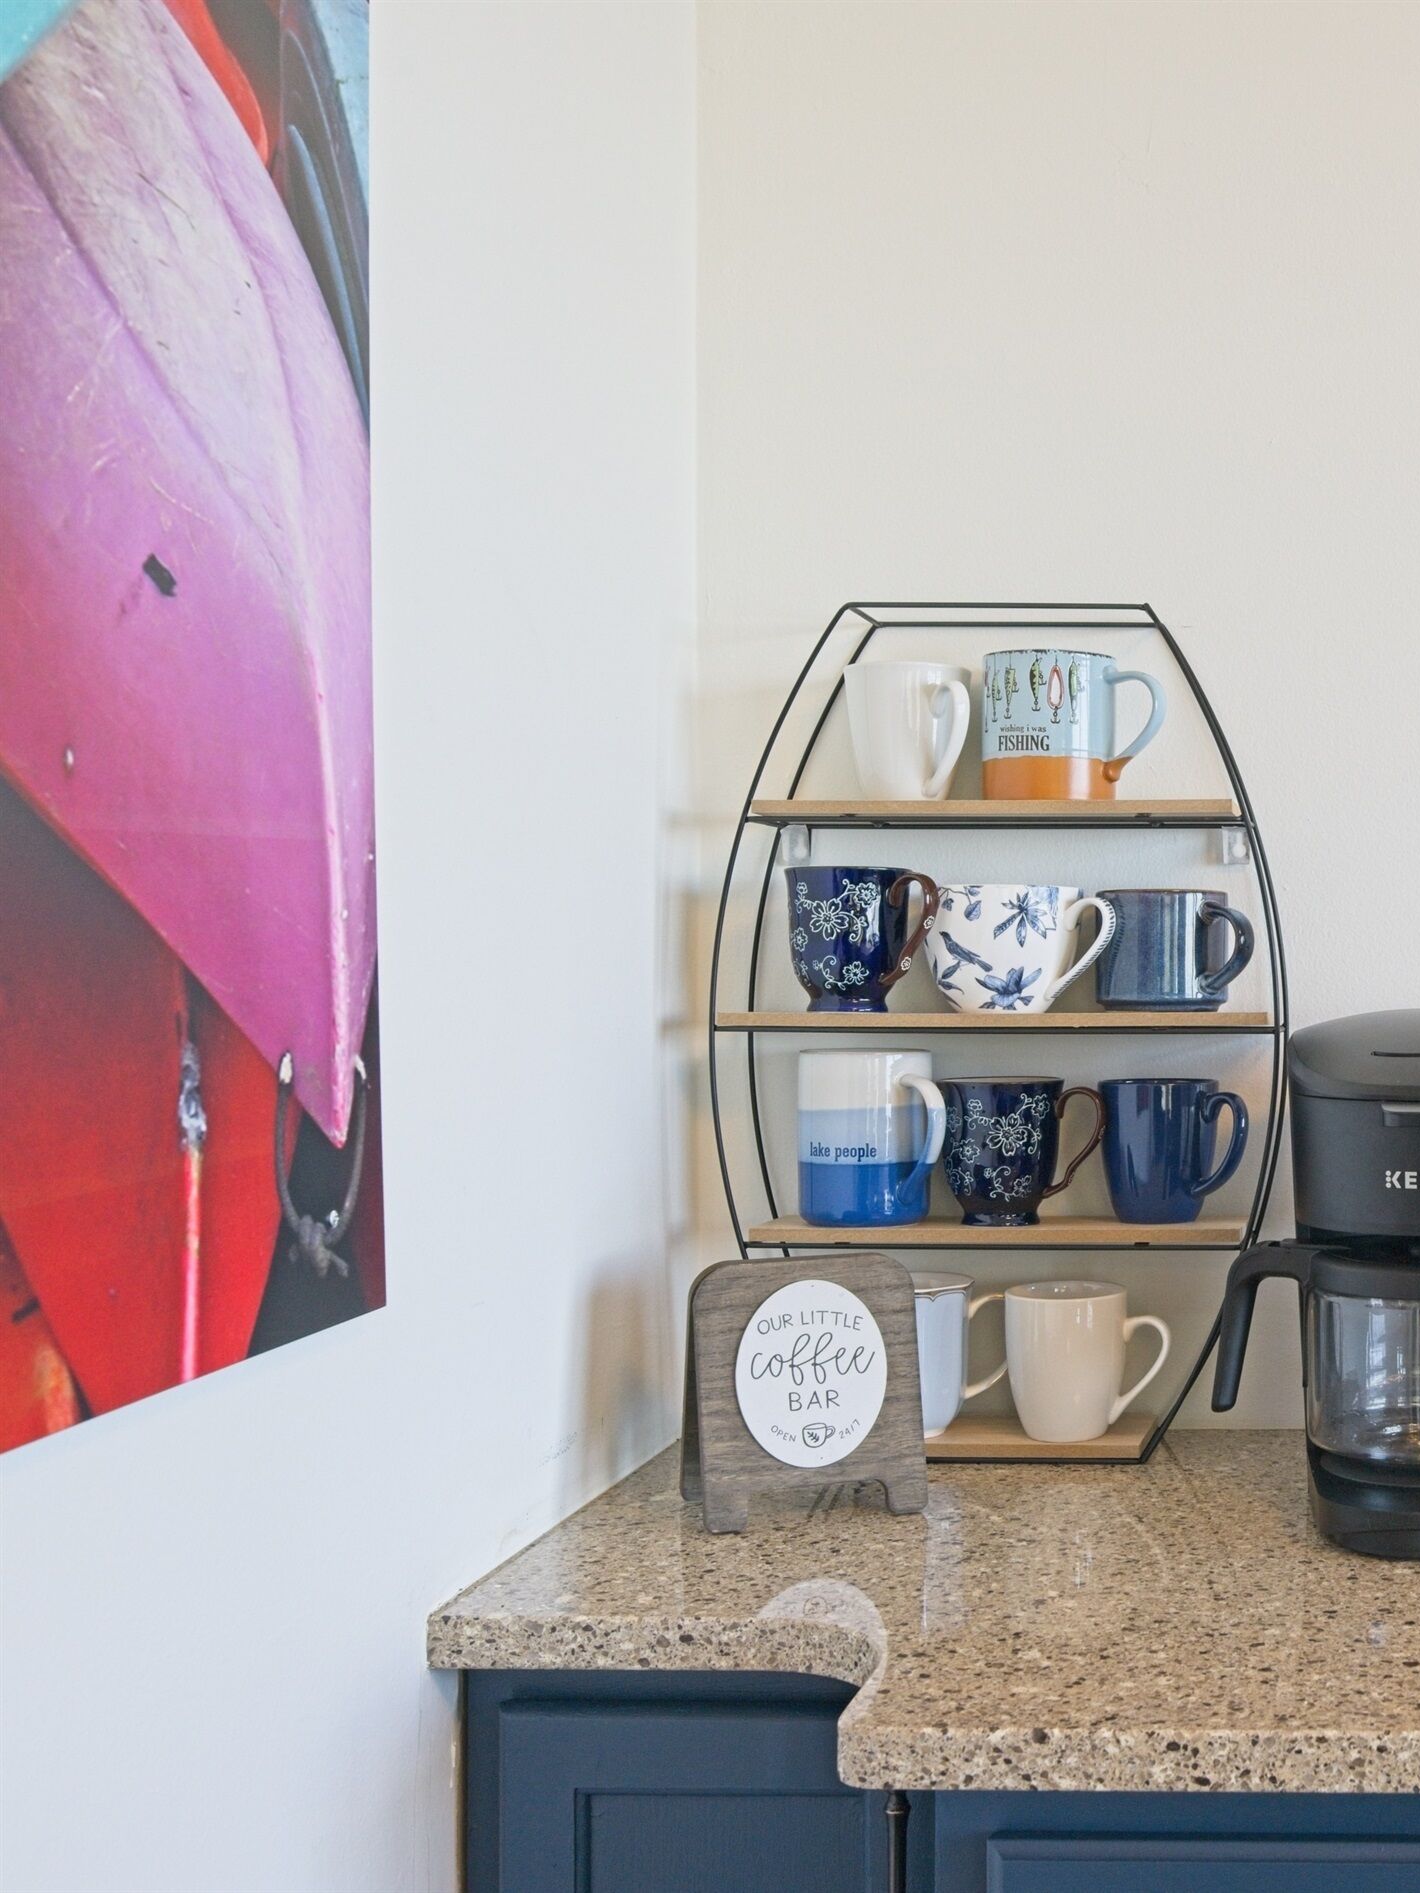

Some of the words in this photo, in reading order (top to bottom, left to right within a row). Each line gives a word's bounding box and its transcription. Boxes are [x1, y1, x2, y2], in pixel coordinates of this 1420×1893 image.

[999, 724, 1025, 733] wishing
[998, 735, 1050, 751] FISHING
[810, 1141, 831, 1158] lake
[834, 1143, 877, 1162] people
[757, 1313, 793, 1335] OUR
[800, 1310, 864, 1331] LITTLE
[751, 1332, 876, 1386] coffee
[788, 1389, 840, 1412] BAR
[770, 1425, 796, 1443] OPEN
[839, 1418, 861, 1440] 24/7
